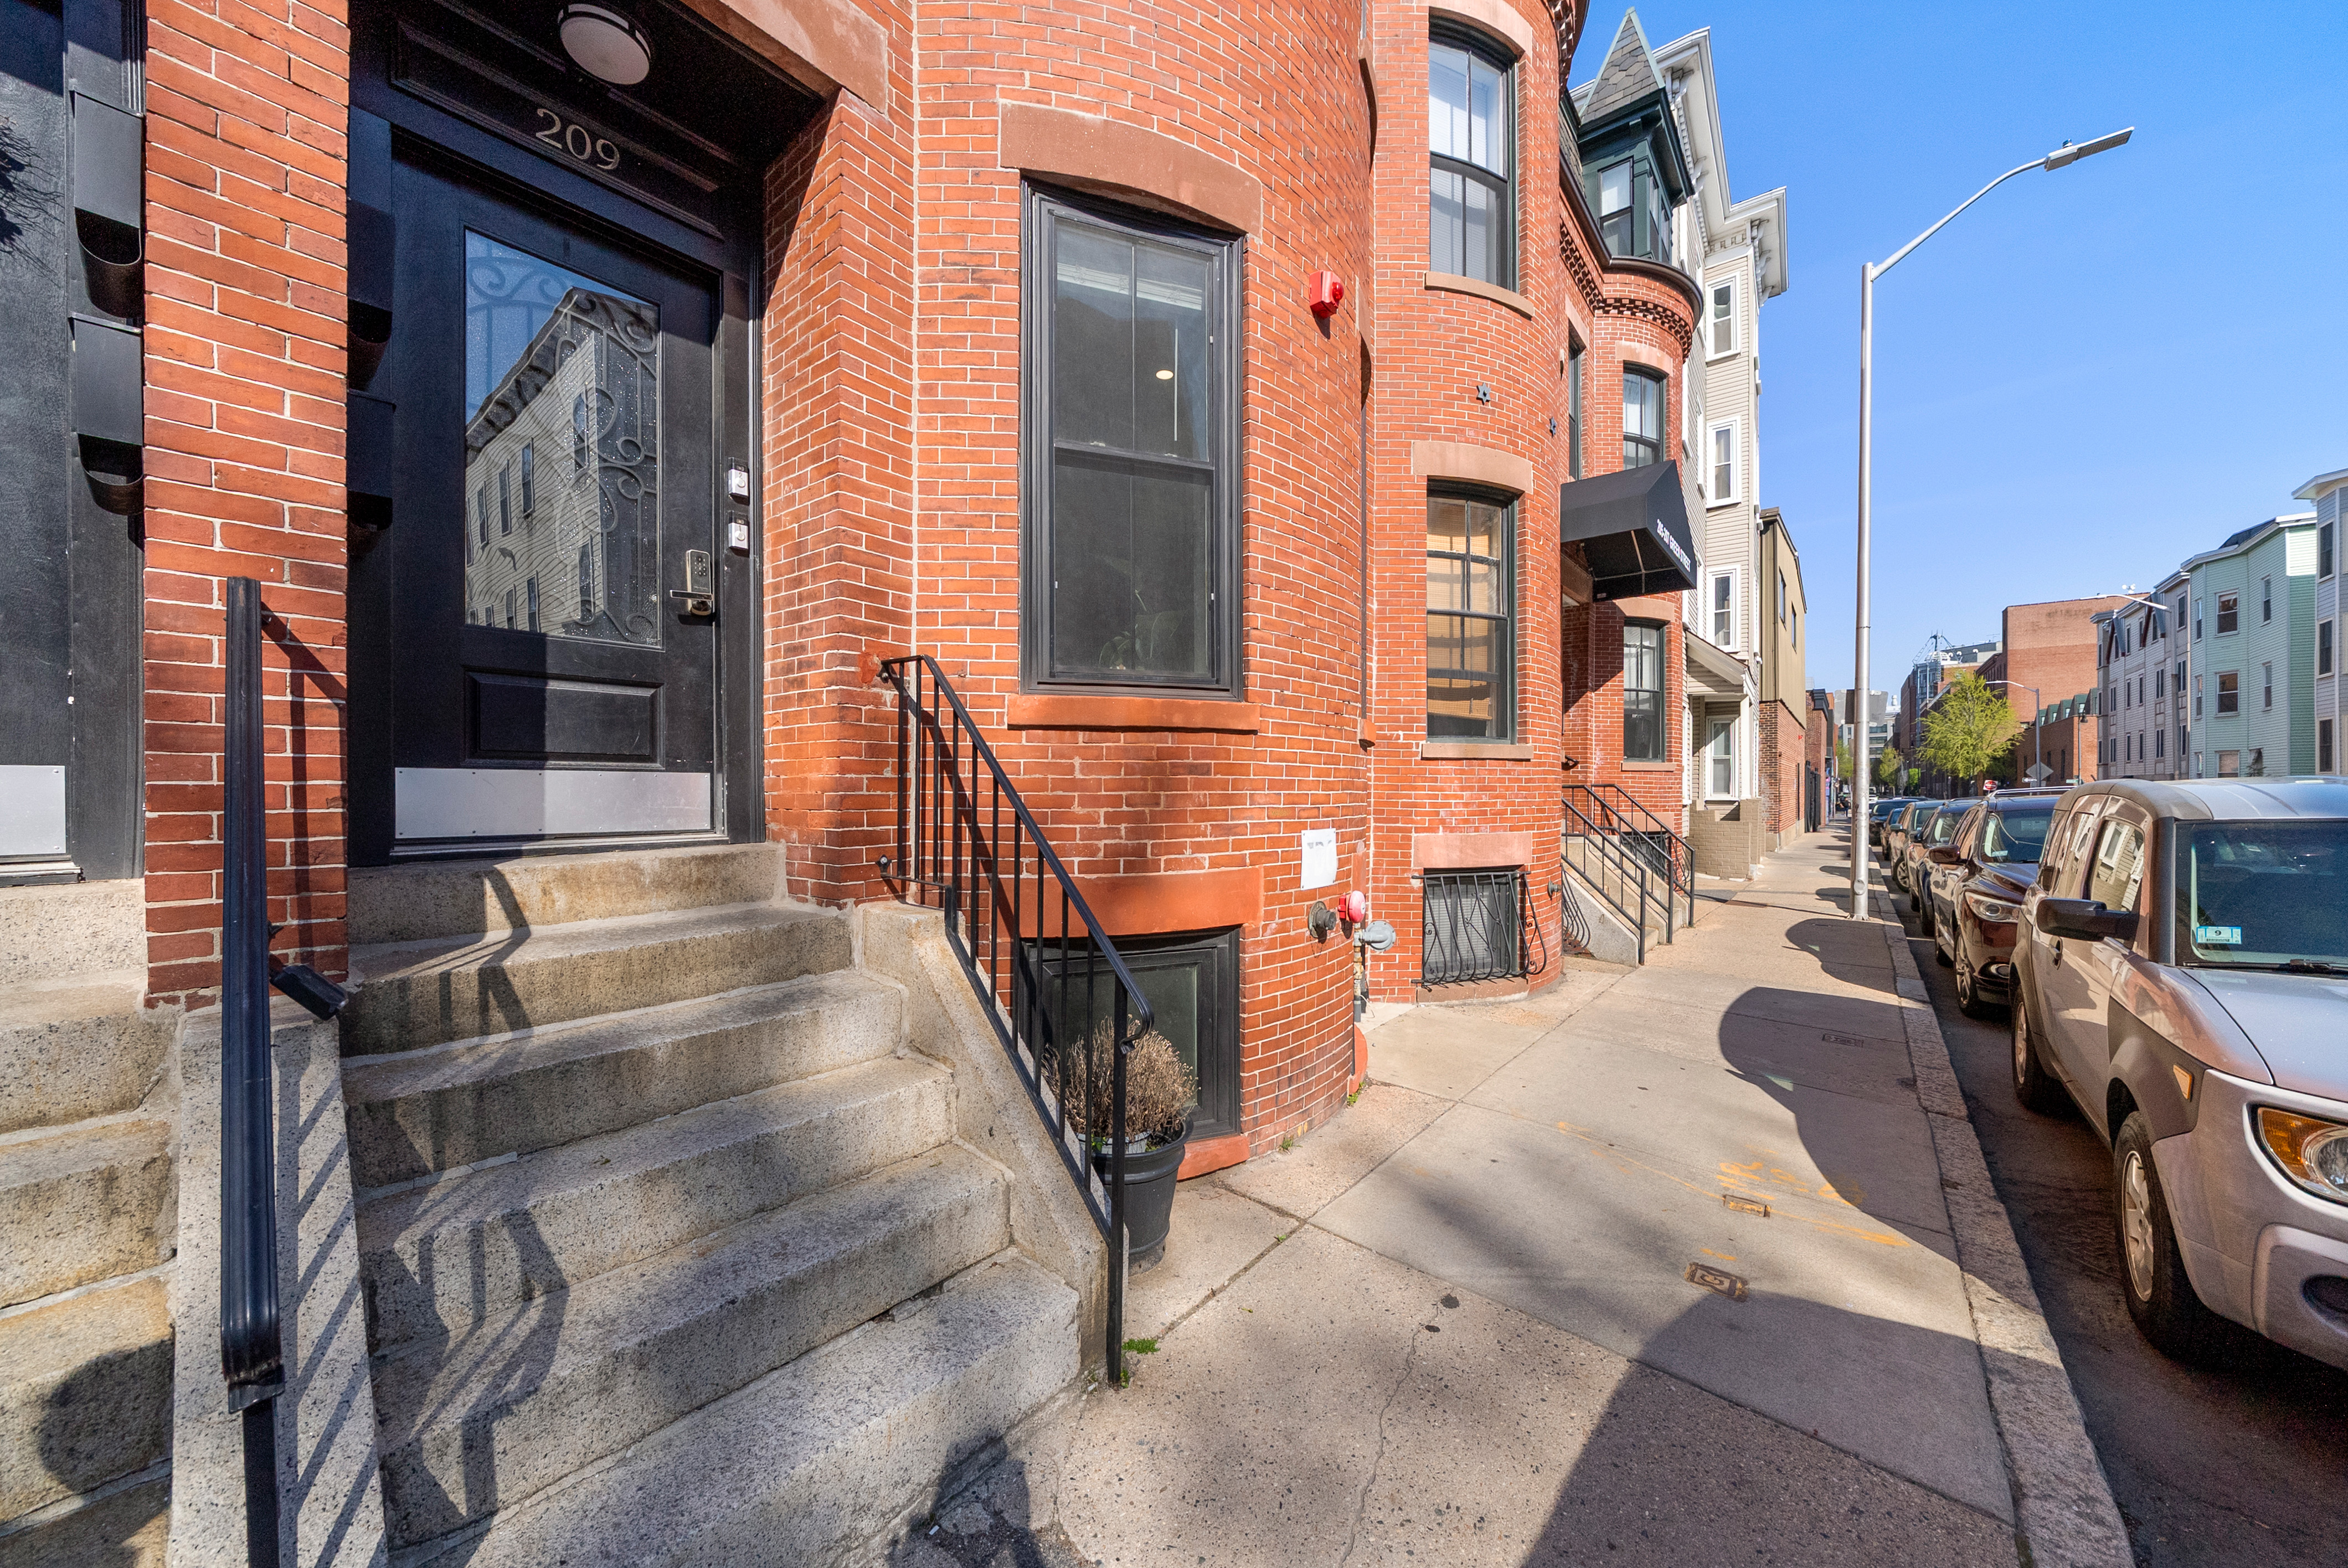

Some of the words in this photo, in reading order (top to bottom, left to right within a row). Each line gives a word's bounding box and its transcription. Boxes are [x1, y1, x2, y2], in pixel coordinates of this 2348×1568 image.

[535, 109, 620, 169] 209
[1669, 535, 1681, 559] GREEN
[1680, 548, 1691, 572] STREET
